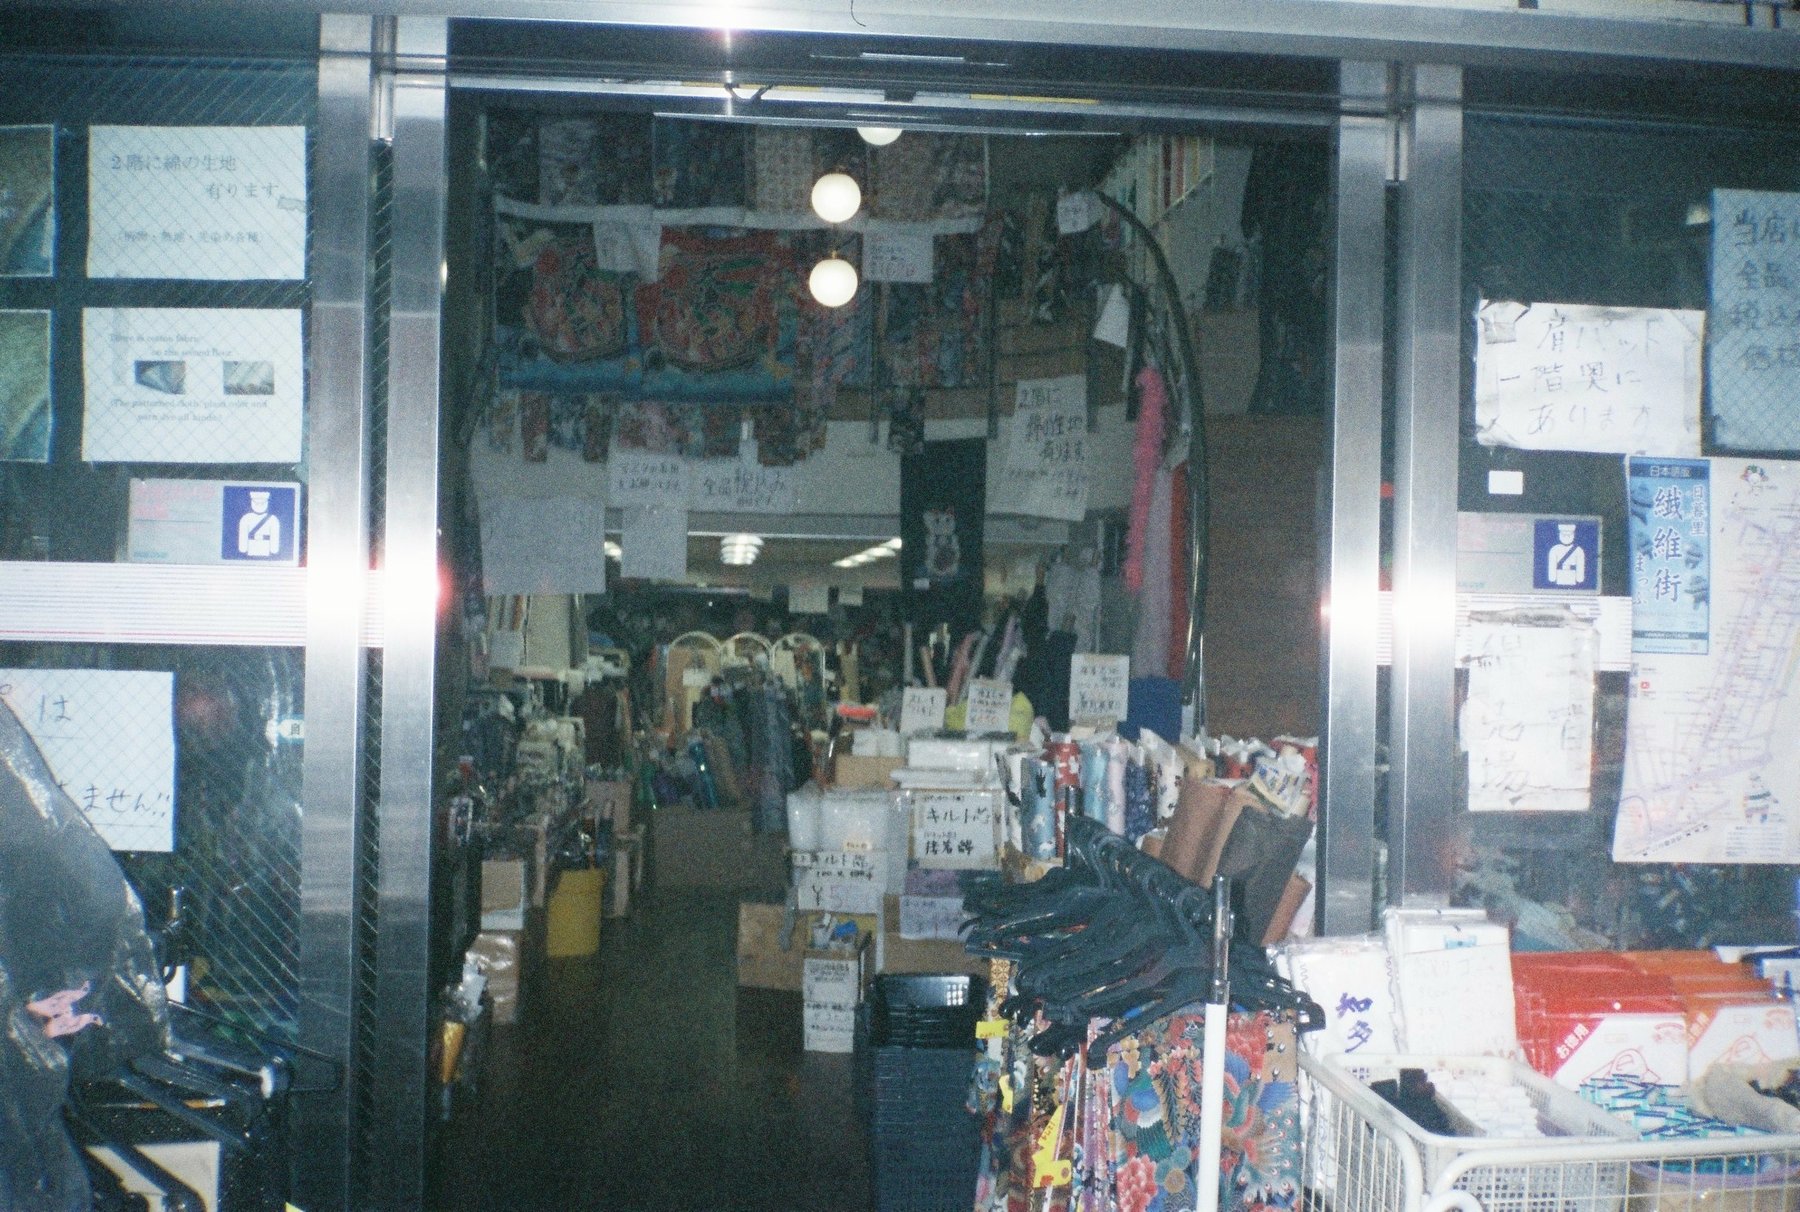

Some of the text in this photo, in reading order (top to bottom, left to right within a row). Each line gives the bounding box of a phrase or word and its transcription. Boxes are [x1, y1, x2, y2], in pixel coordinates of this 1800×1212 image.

[1653, 486, 1683, 603] 繊維街
[1555, 1022, 1590, 1059] お徳用
